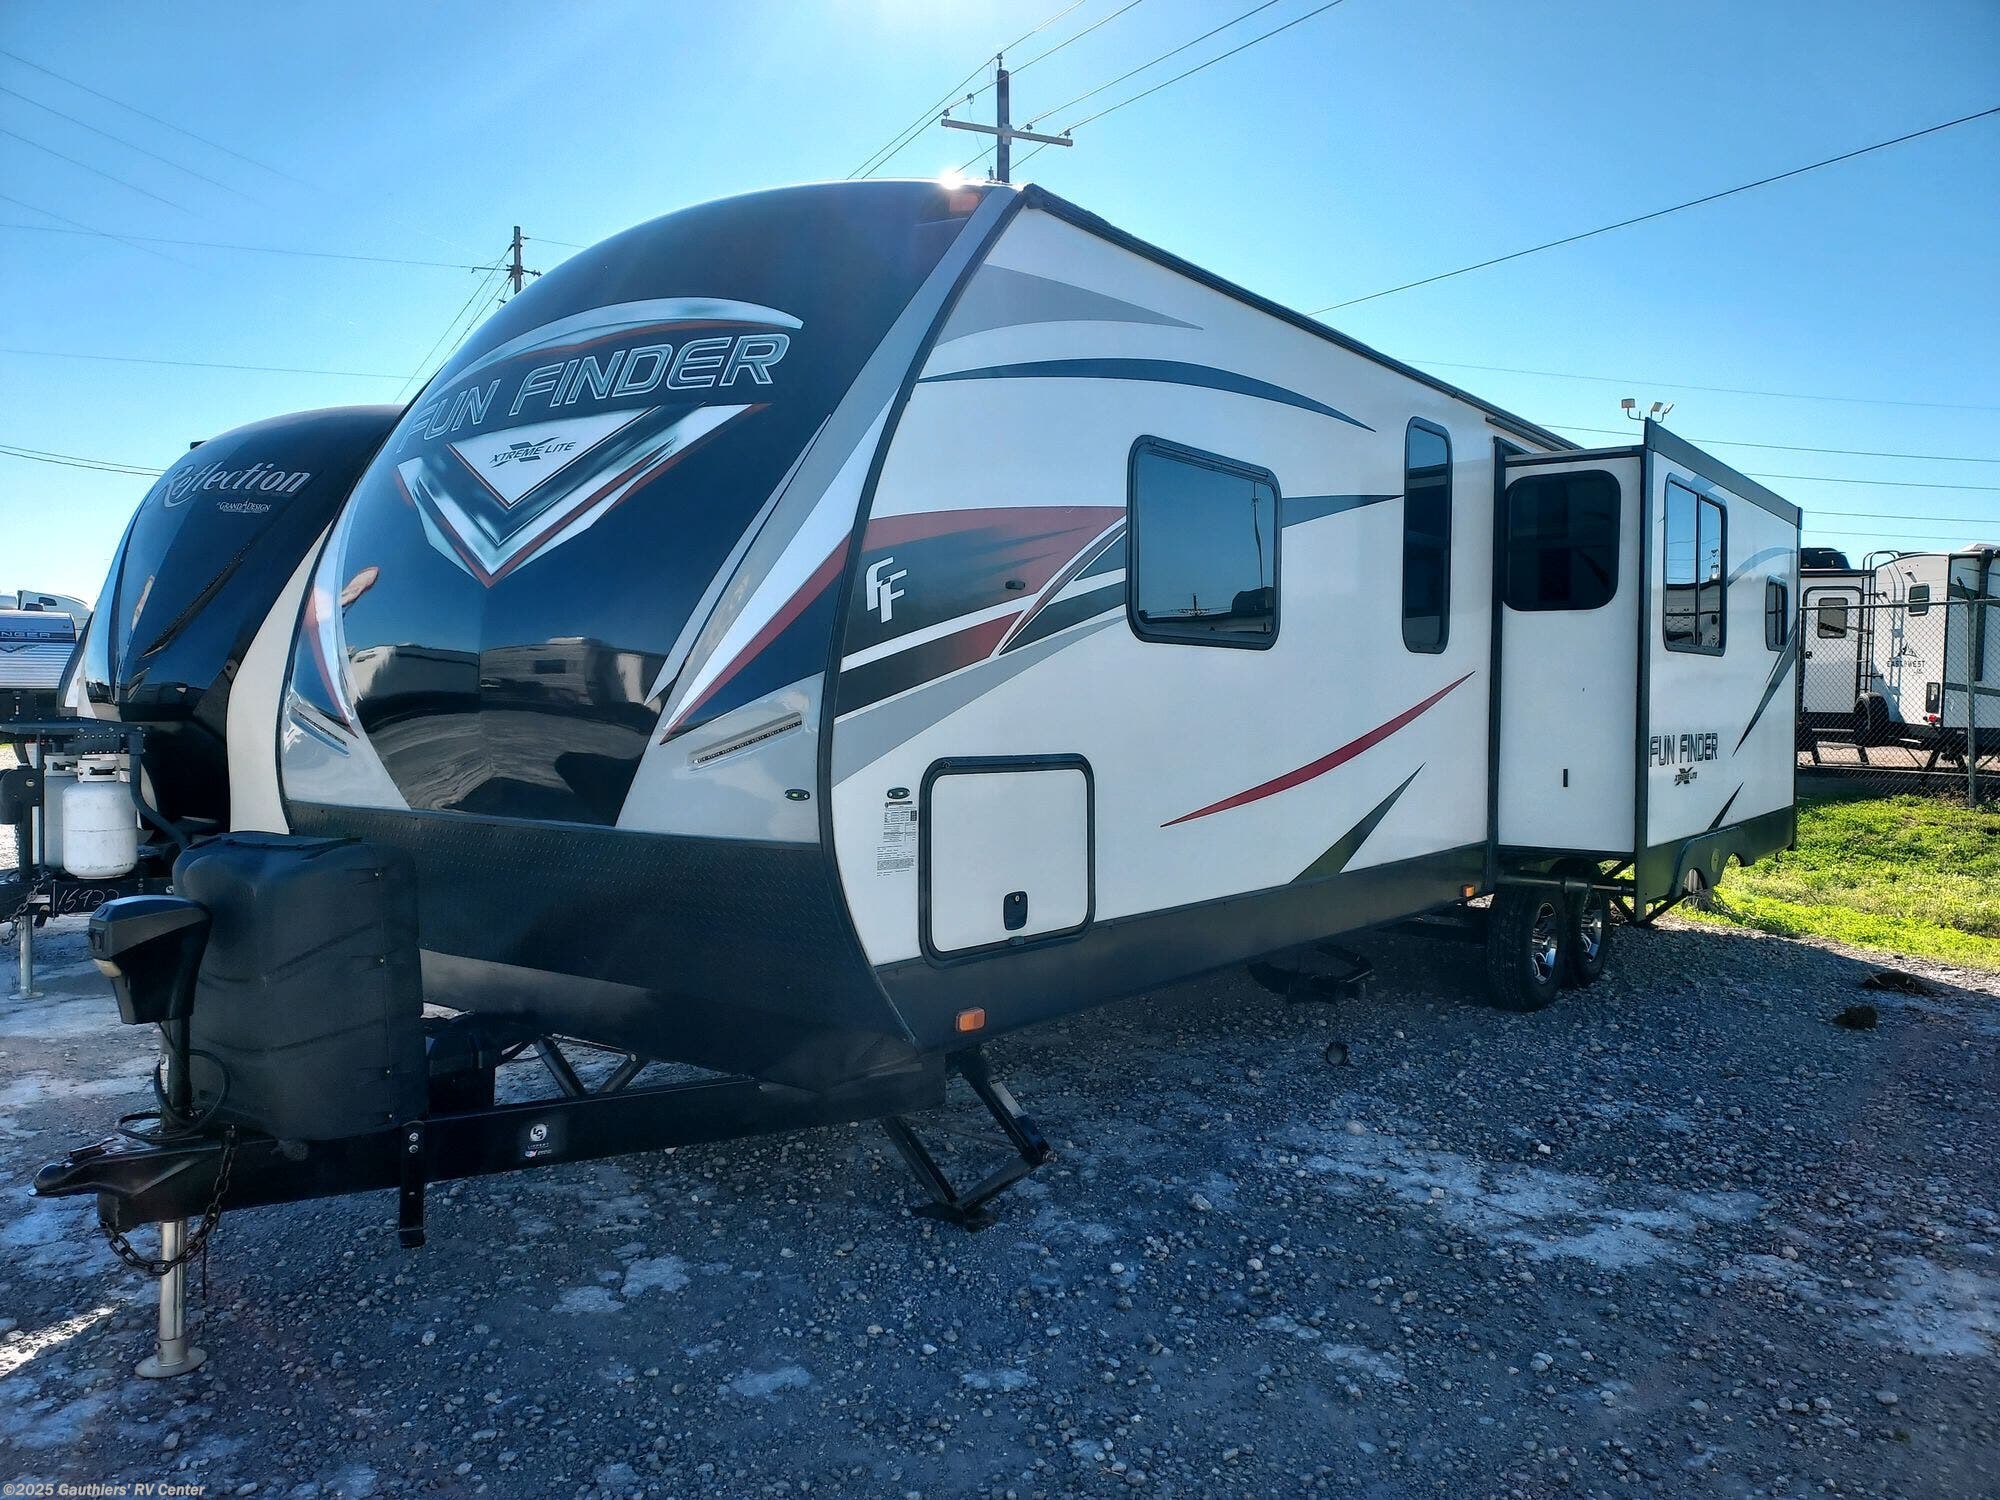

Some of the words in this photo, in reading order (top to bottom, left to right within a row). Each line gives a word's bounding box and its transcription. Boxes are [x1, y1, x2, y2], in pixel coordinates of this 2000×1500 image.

[396, 378, 501, 454] FUN
[508, 333, 790, 417] FINDER
[489, 446, 545, 463] XTREME
[545, 441, 577, 454] LITE
[164, 460, 311, 508] Reflection
[1649, 734, 1676, 767] FUN
[1679, 732, 1719, 764] FINDER
